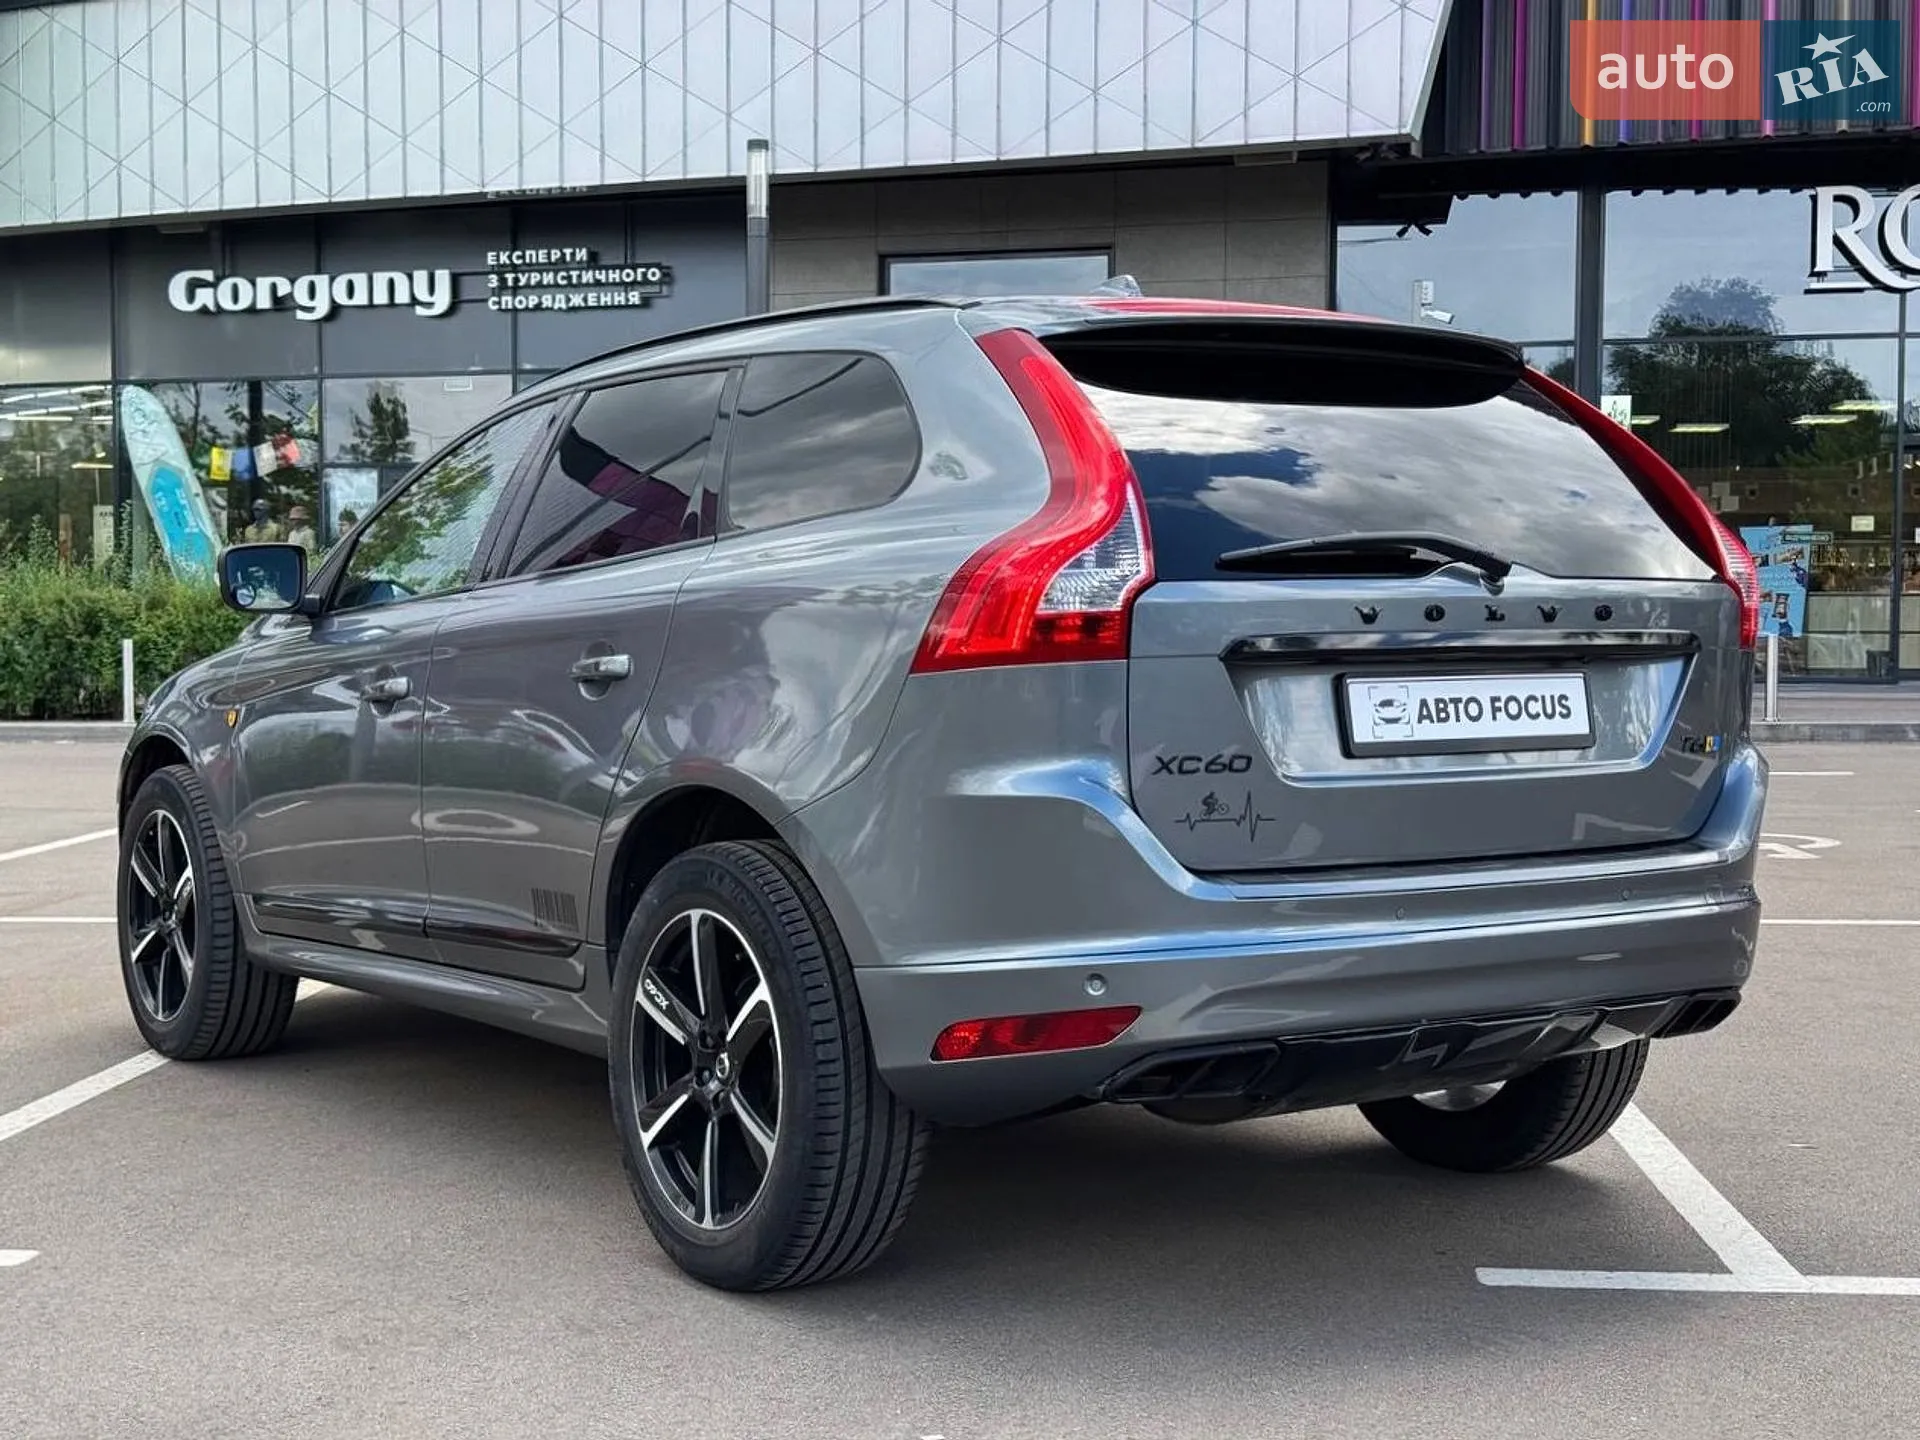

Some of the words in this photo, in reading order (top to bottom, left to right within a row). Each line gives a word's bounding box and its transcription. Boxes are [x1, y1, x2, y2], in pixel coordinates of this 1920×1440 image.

[487, 248, 588, 266] ЕКСПЕРТИ
[504, 267, 662, 288] ТУРИСТИЧНОГО
[168, 269, 452, 321] Gorgany
[487, 291, 642, 311] СПОРЯДЖЕННЯ
[1354, 604, 1613, 625] VOLVO
[1489, 694, 1572, 722] FOCUS
[1152, 754, 1253, 776] XC60
